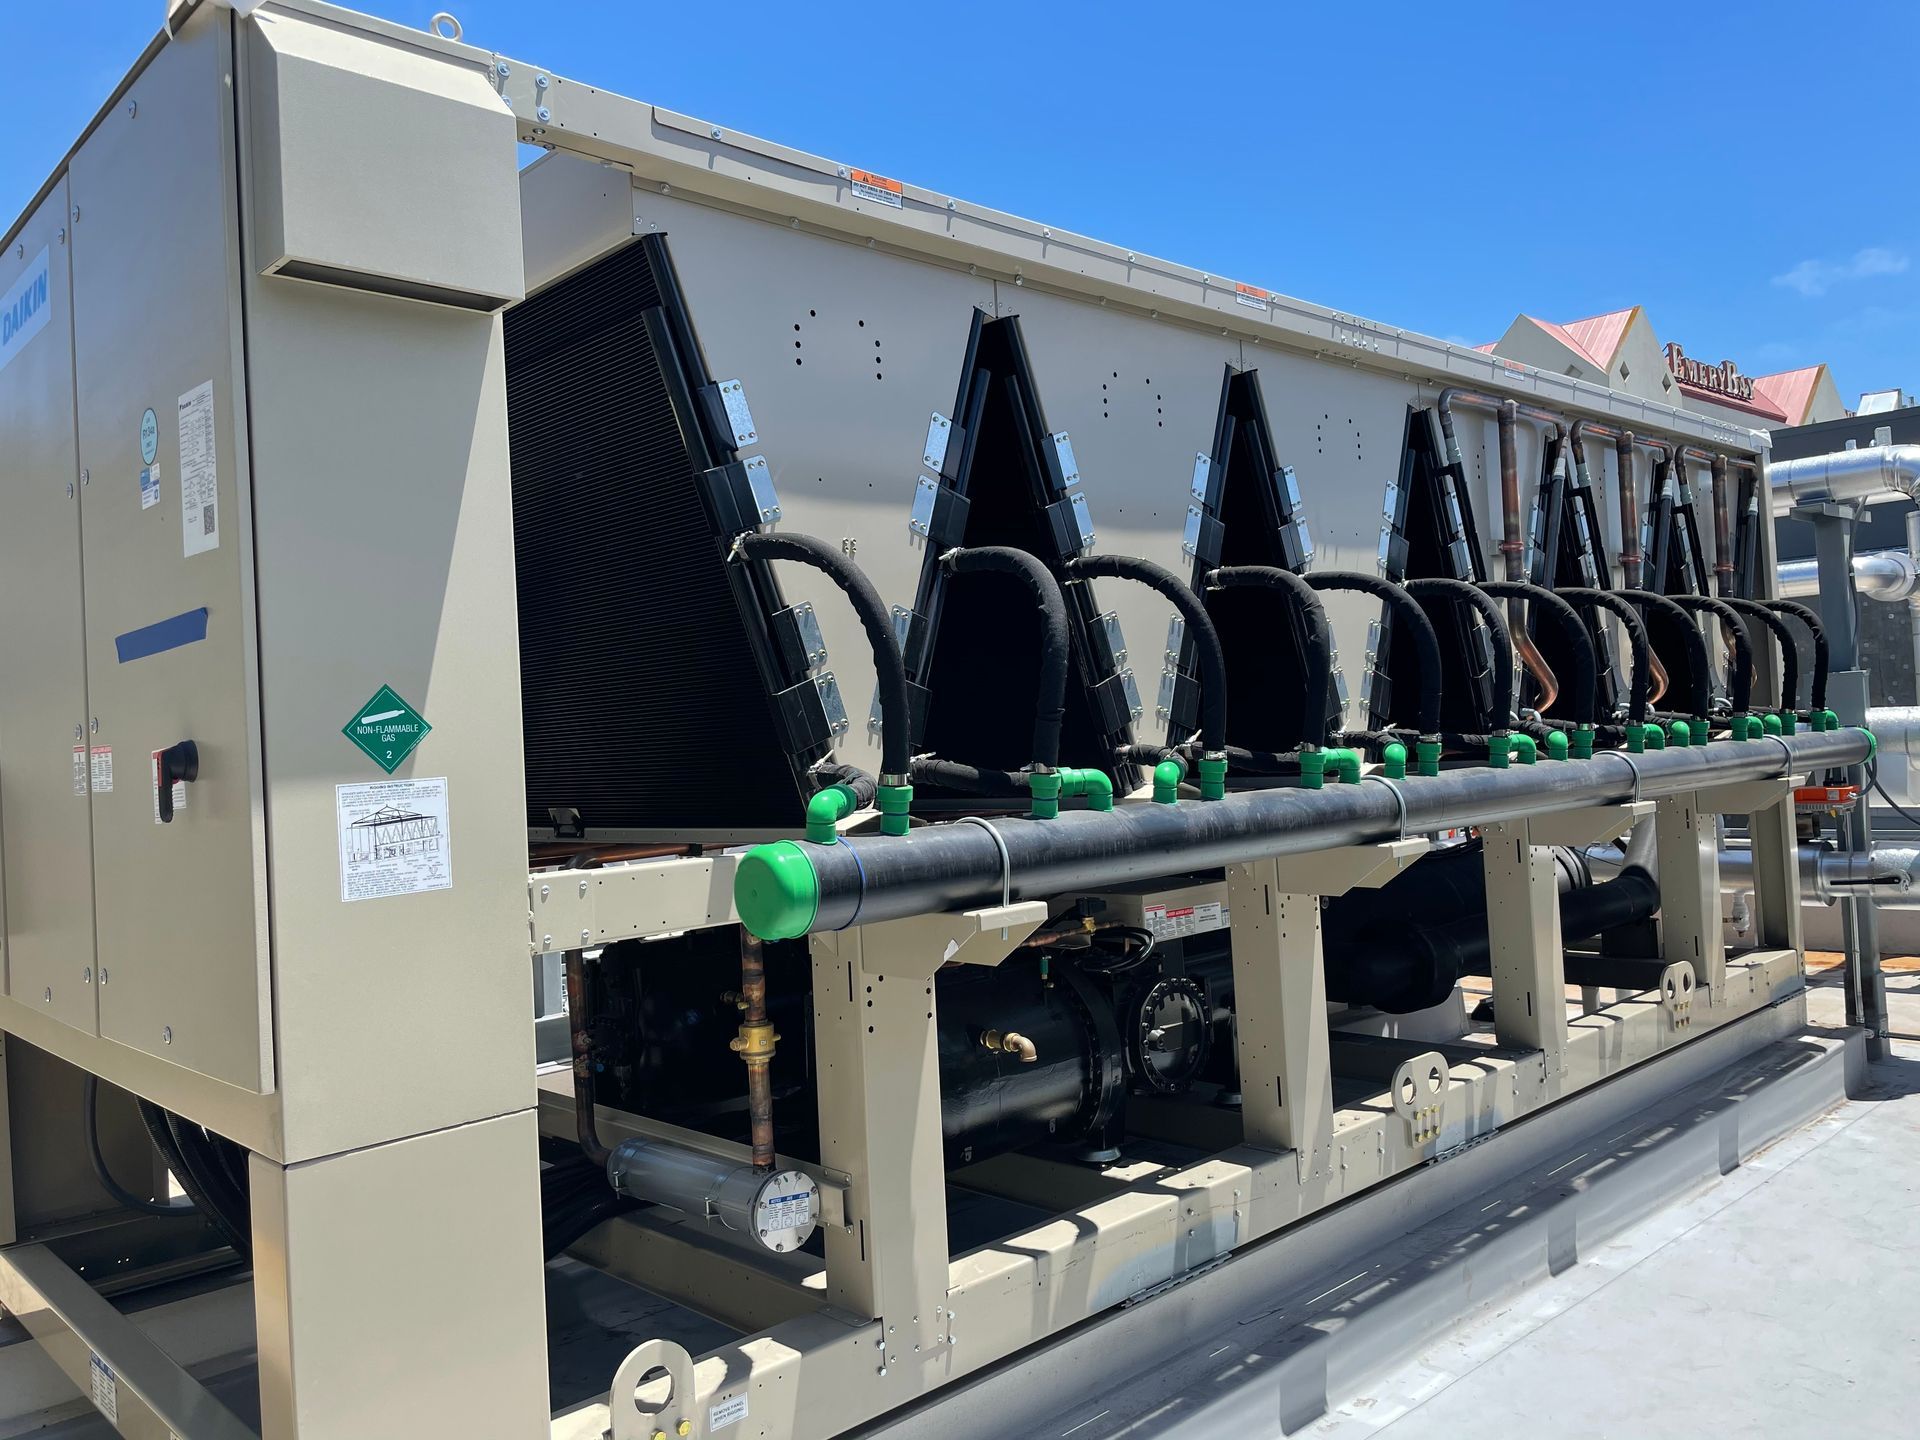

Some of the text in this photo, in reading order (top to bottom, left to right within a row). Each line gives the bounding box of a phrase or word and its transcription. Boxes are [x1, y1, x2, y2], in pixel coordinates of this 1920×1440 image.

[3, 268, 47, 346] DAIKIN
[357, 724, 419, 735] NON-FLAMMABLE
[381, 734, 396, 743] GAS
[386, 750, 393, 759] 2
